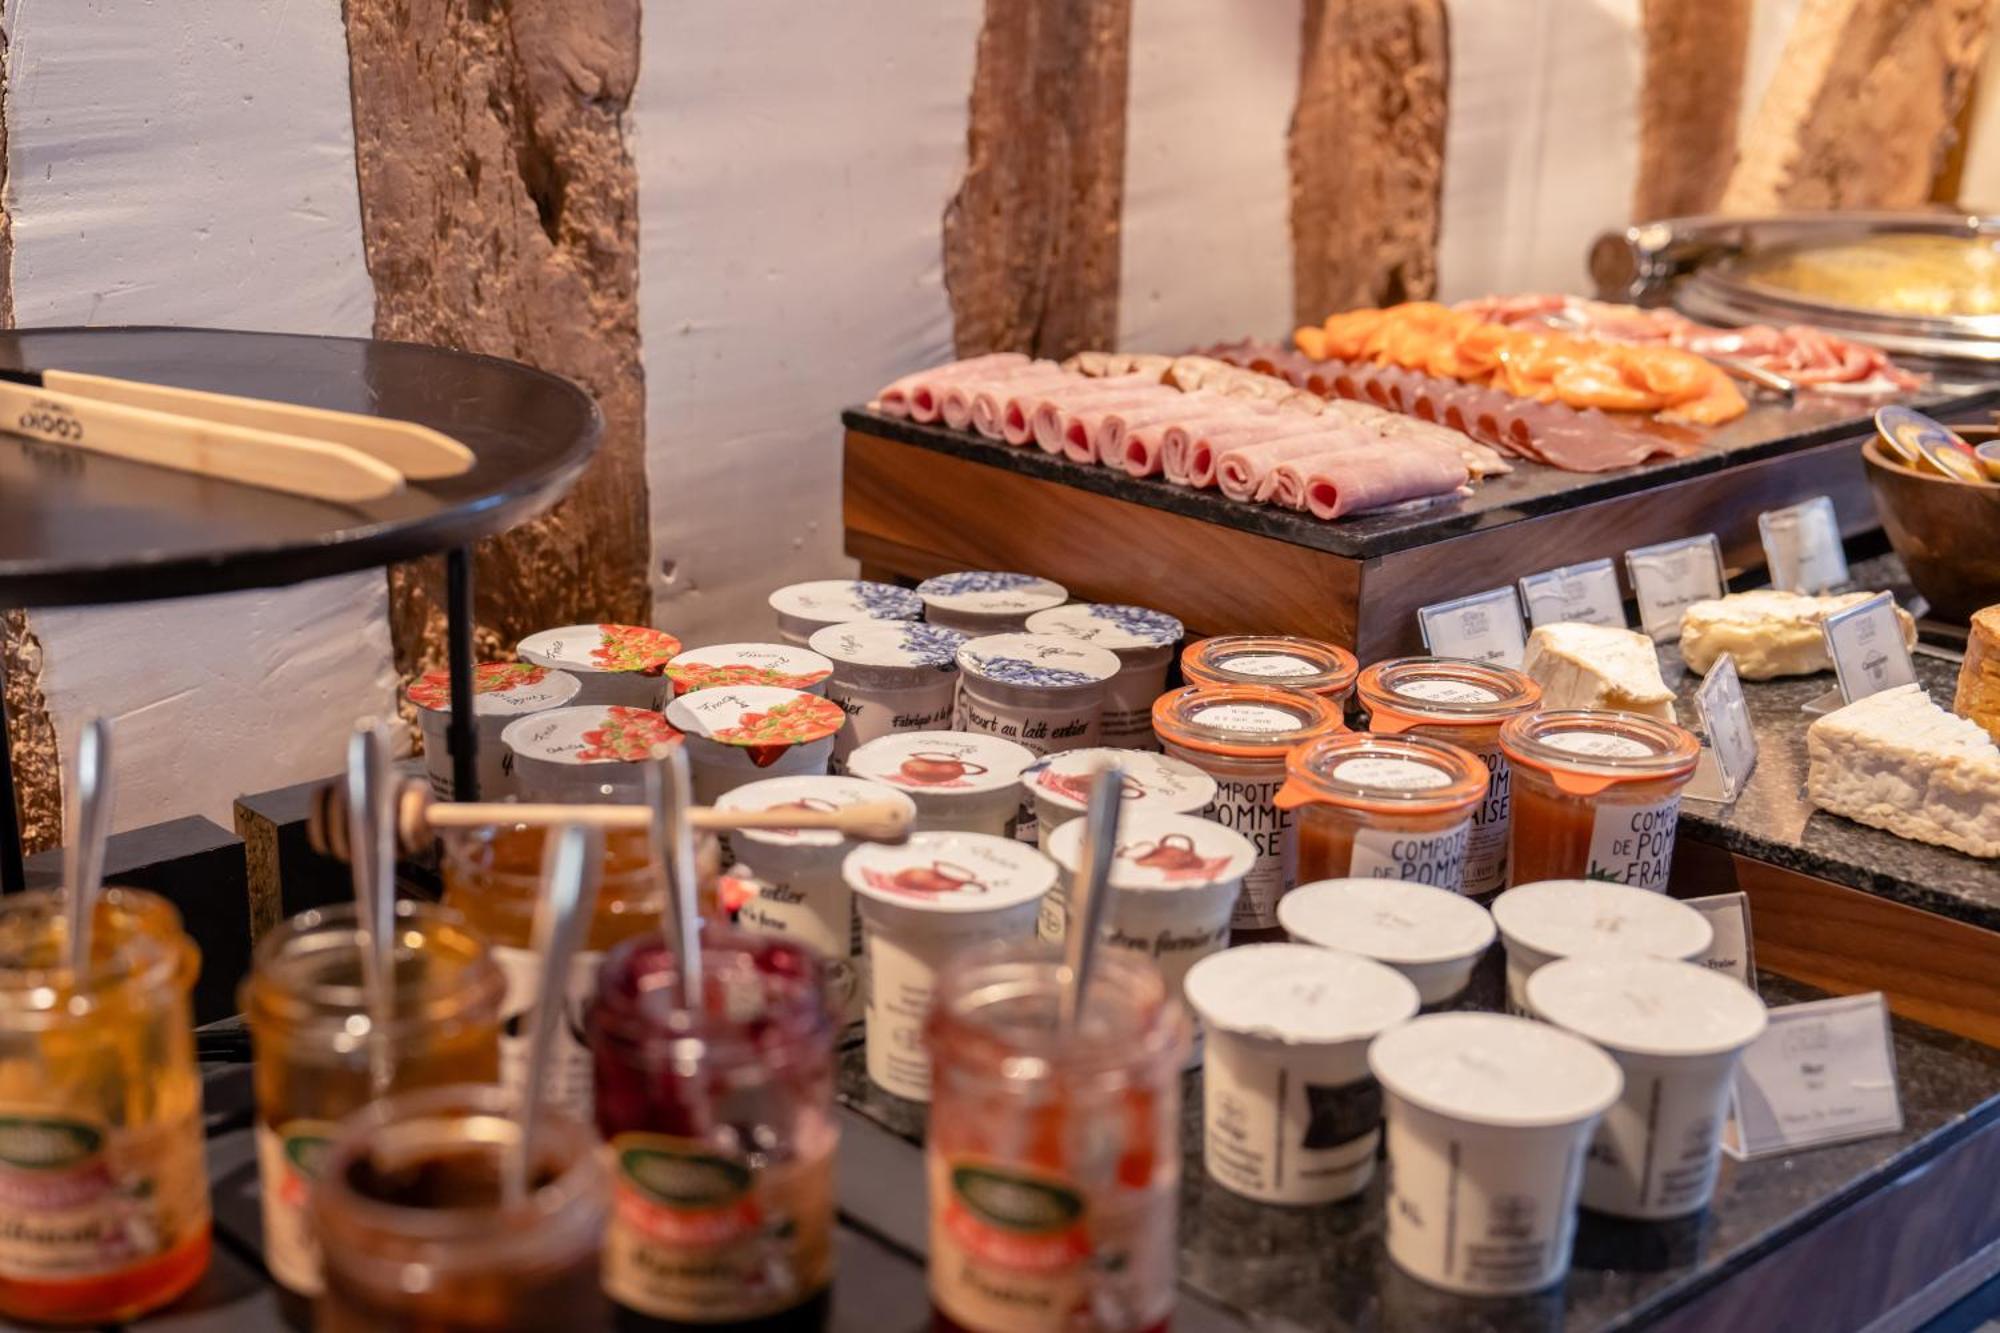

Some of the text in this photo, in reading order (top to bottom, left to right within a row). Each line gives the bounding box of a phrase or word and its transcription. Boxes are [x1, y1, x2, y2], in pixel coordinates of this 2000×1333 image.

[1001, 725, 1017, 737] au
[1022, 715, 1048, 739] lait
[1216, 782, 1284, 803] MPOTE
[1612, 839, 1632, 856] DE
